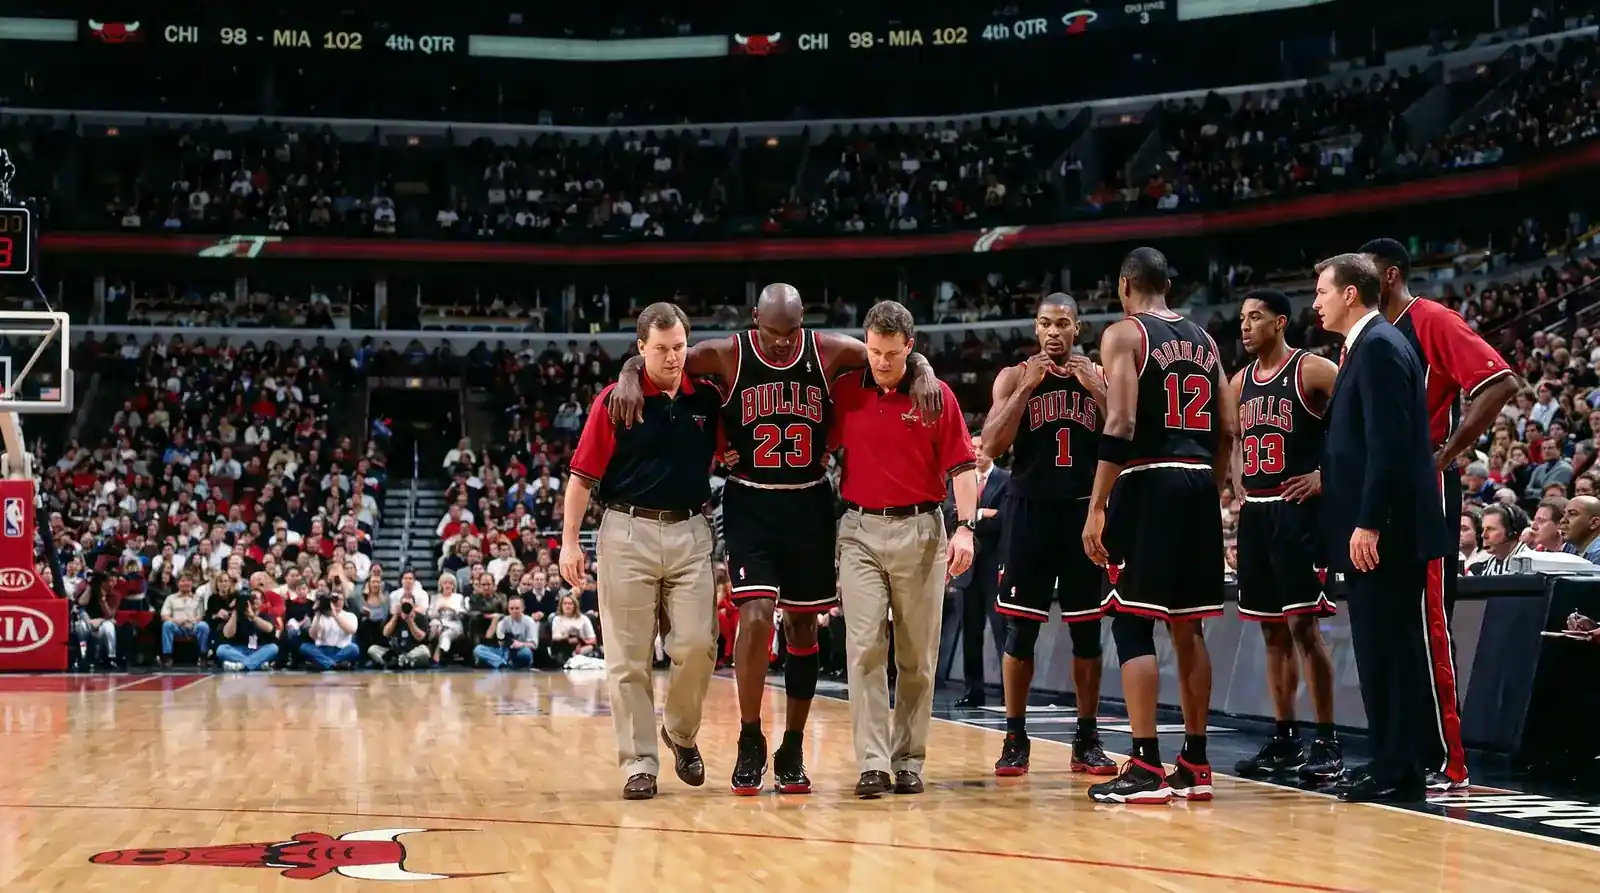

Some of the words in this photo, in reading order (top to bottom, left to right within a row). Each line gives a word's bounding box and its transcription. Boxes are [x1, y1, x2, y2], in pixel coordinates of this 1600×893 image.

[798, 33, 829, 51] CHI
[848, 31, 874, 49] 98
[889, 29, 924, 46] MIA
[933, 27, 968, 45] 102
[981, 23, 1010, 41] 4th
[1013, 17, 1048, 39] QTR
[1140, 12, 1150, 24] 3
[164, 24, 198, 43] CHI
[220, 27, 248, 46] 98
[273, 29, 311, 48] MIA
[323, 31, 362, 50] 102
[385, 34, 415, 51] 4th
[418, 35, 455, 54] QTR
[741, 381, 823, 426] BULLS
[1028, 389, 1096, 432] BULLS
[1164, 372, 1212, 431] 12
[753, 423, 812, 468] 23
[1055, 427, 1073, 467] 1
[1243, 432, 1286, 477] 33
[0, 572, 27, 587] KIA
[0, 616, 40, 642] IA
